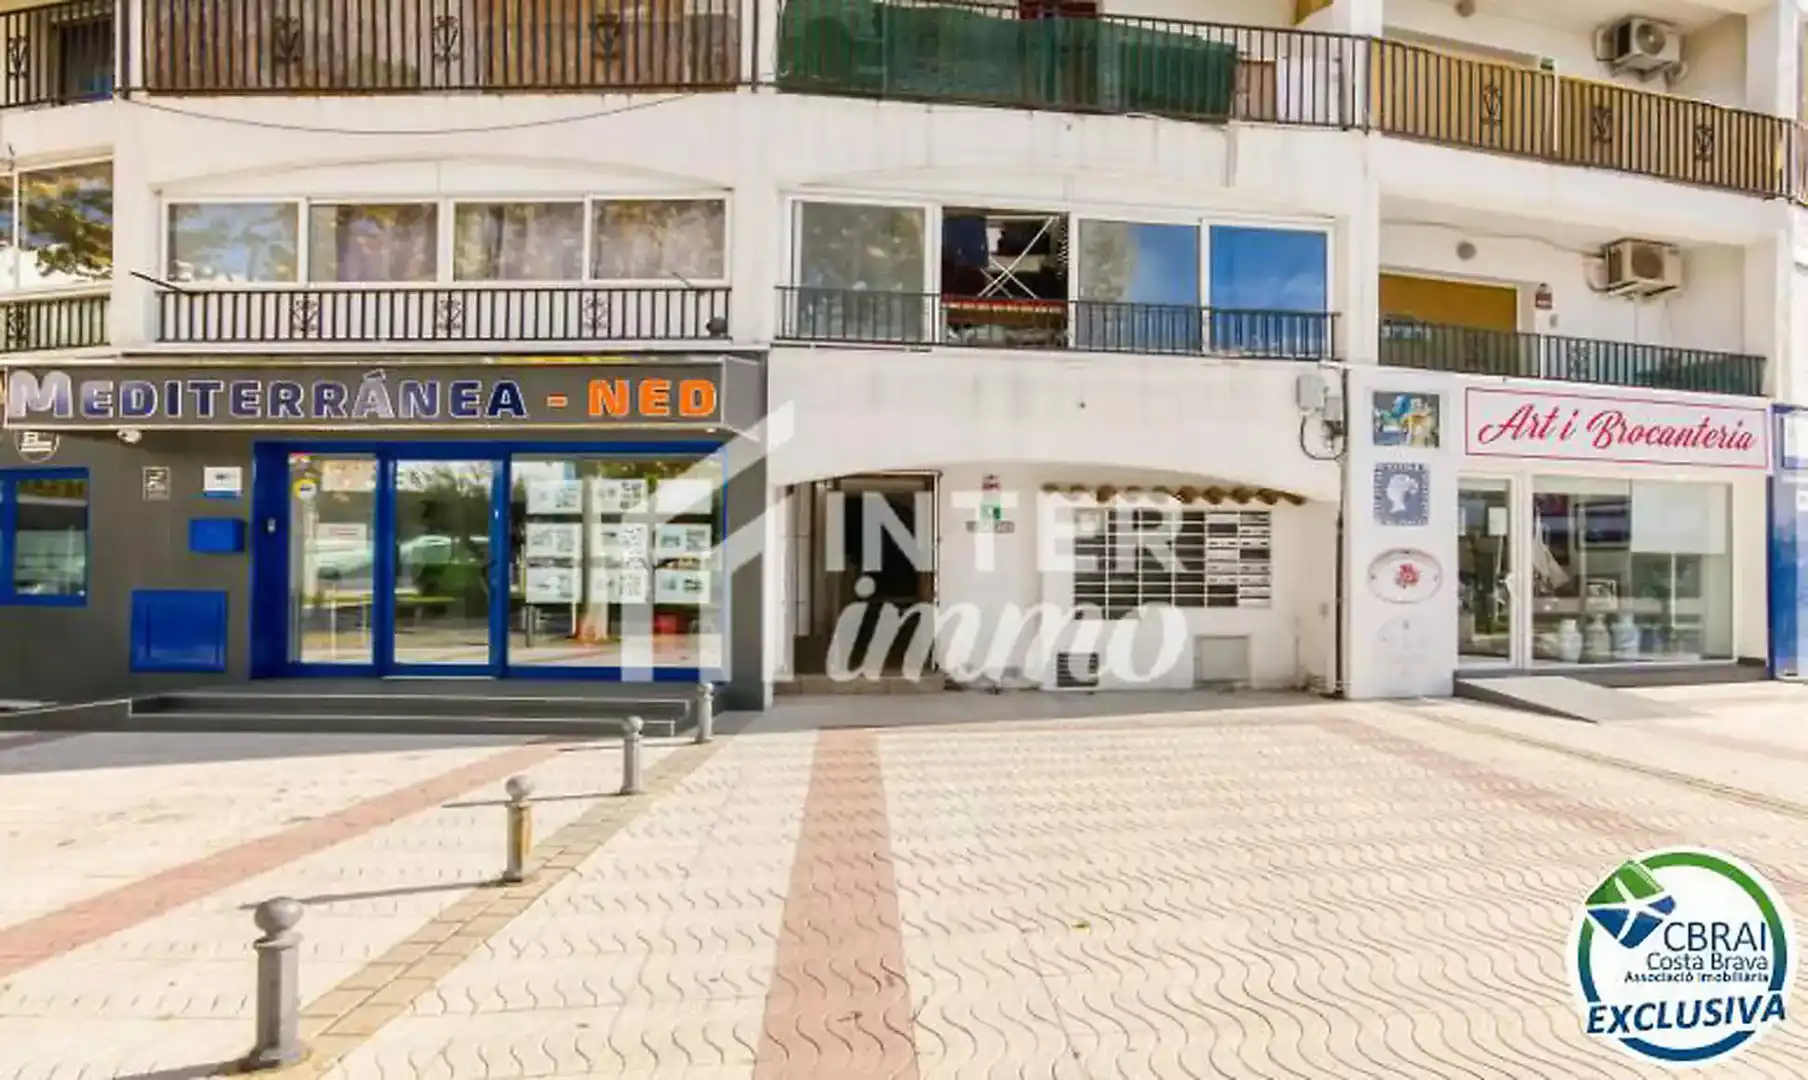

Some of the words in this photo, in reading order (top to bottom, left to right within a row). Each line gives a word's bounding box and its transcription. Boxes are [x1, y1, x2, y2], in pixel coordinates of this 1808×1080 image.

[8, 368, 529, 419] MEDITERRÁNEA
[587, 378, 717, 418] NED
[1477, 403, 1560, 445] Art
[1560, 408, 1579, 442] i
[1586, 410, 1757, 451] Brocanteria
